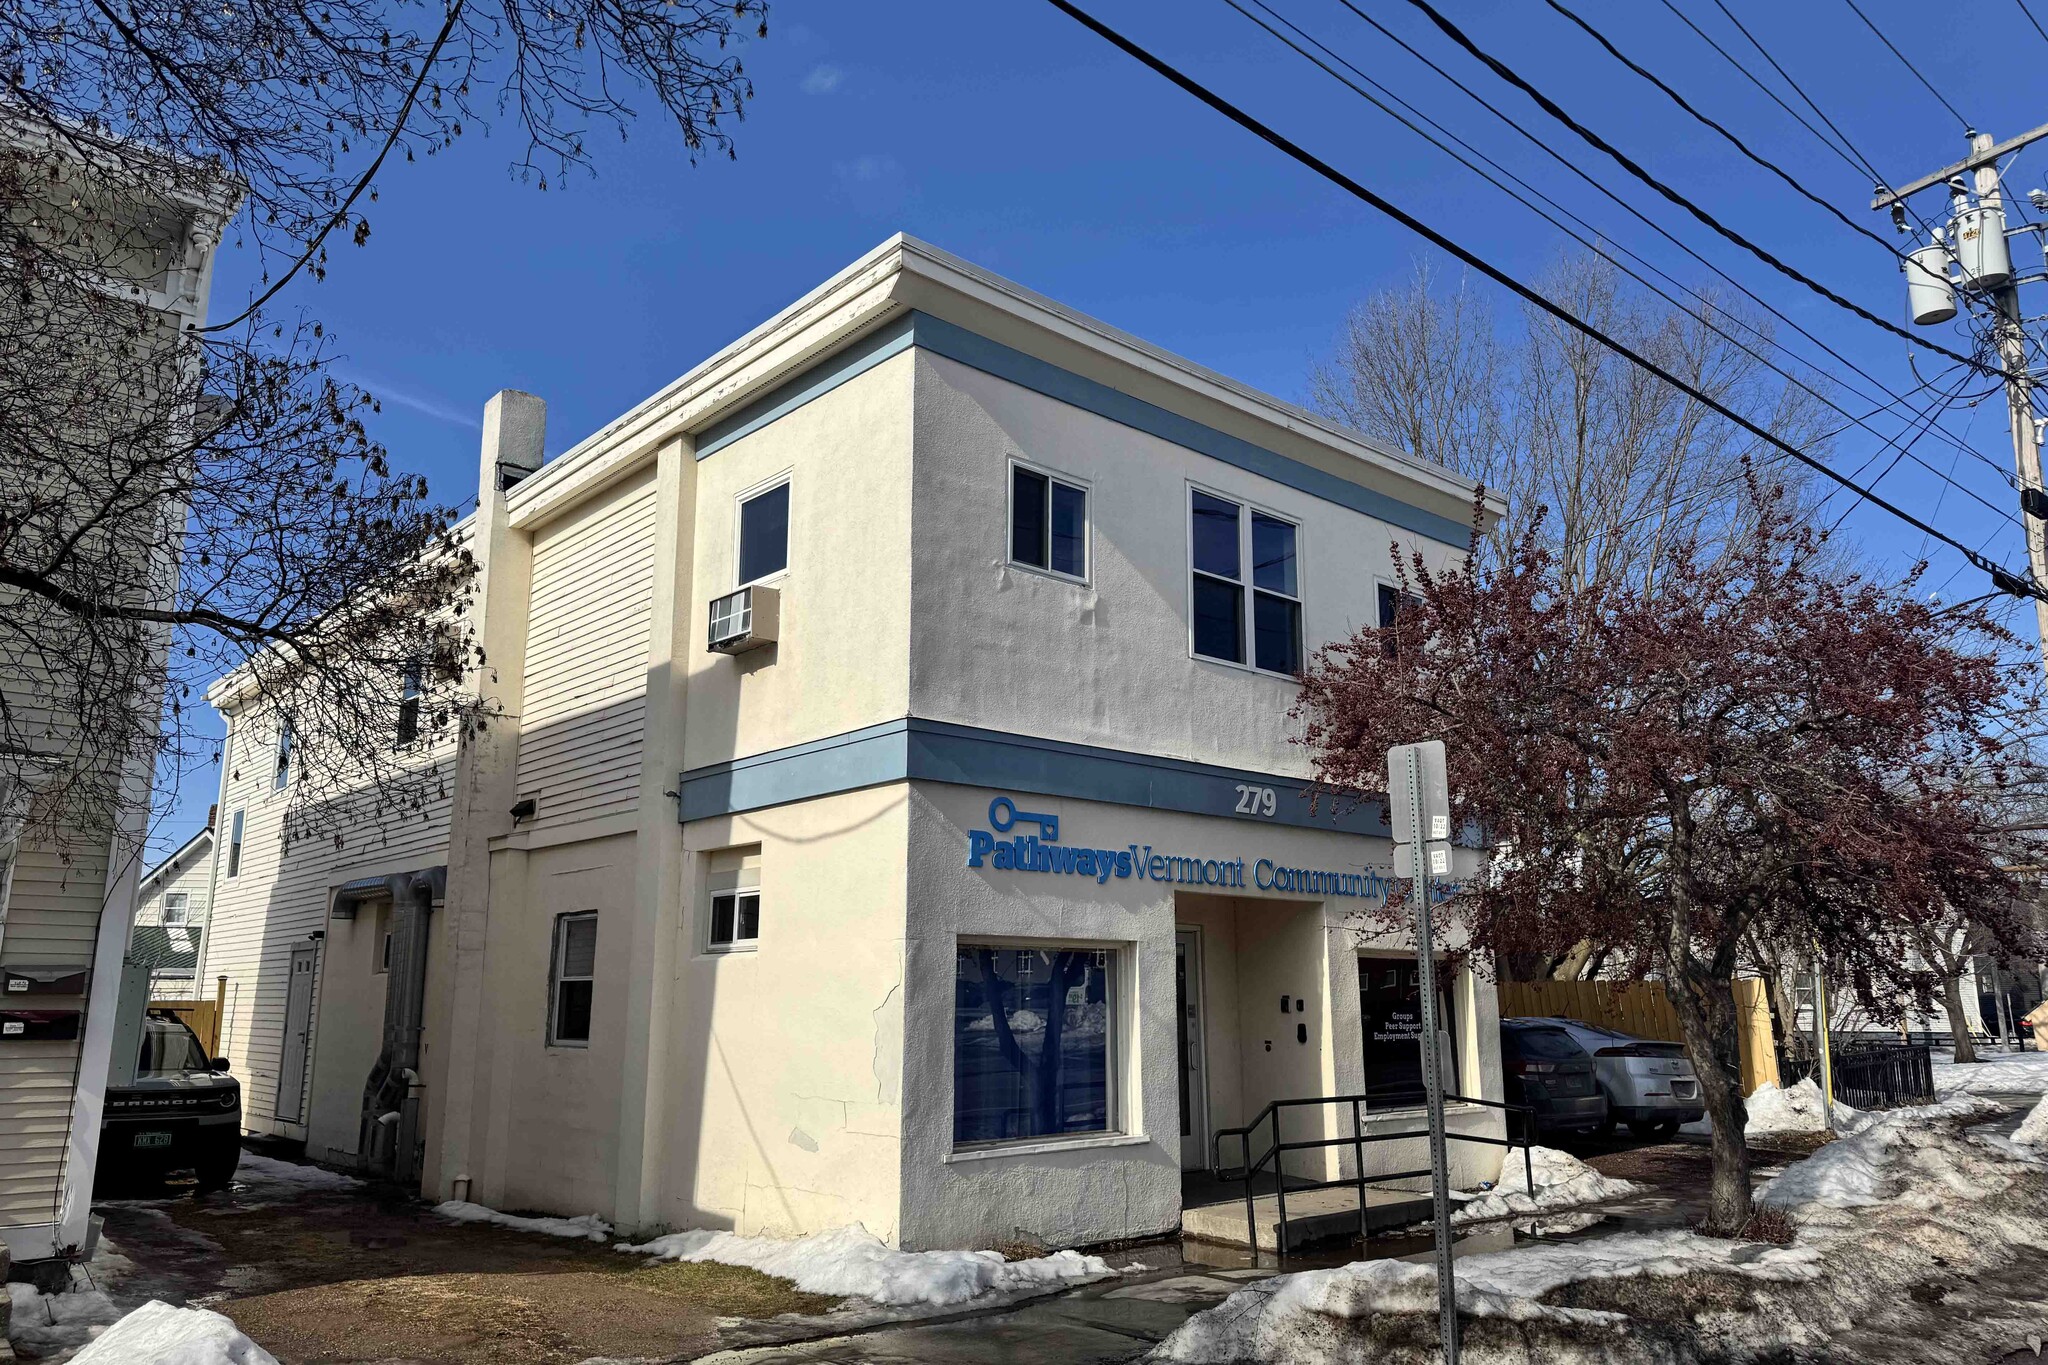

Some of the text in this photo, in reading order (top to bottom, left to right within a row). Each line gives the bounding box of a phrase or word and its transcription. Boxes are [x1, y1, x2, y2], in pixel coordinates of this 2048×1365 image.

[1235, 784, 1277, 817] 279
[967, 829, 1131, 885] Pathways
[1128, 844, 1246, 888] Vermont
[1253, 858, 1391, 908] Community
[1392, 1011, 1414, 1022] Groups
[1385, 1021, 1421, 1032] Peer Support
[1374, 1031, 1410, 1042] Employment
[113, 1099, 198, 1107] BRONCO
